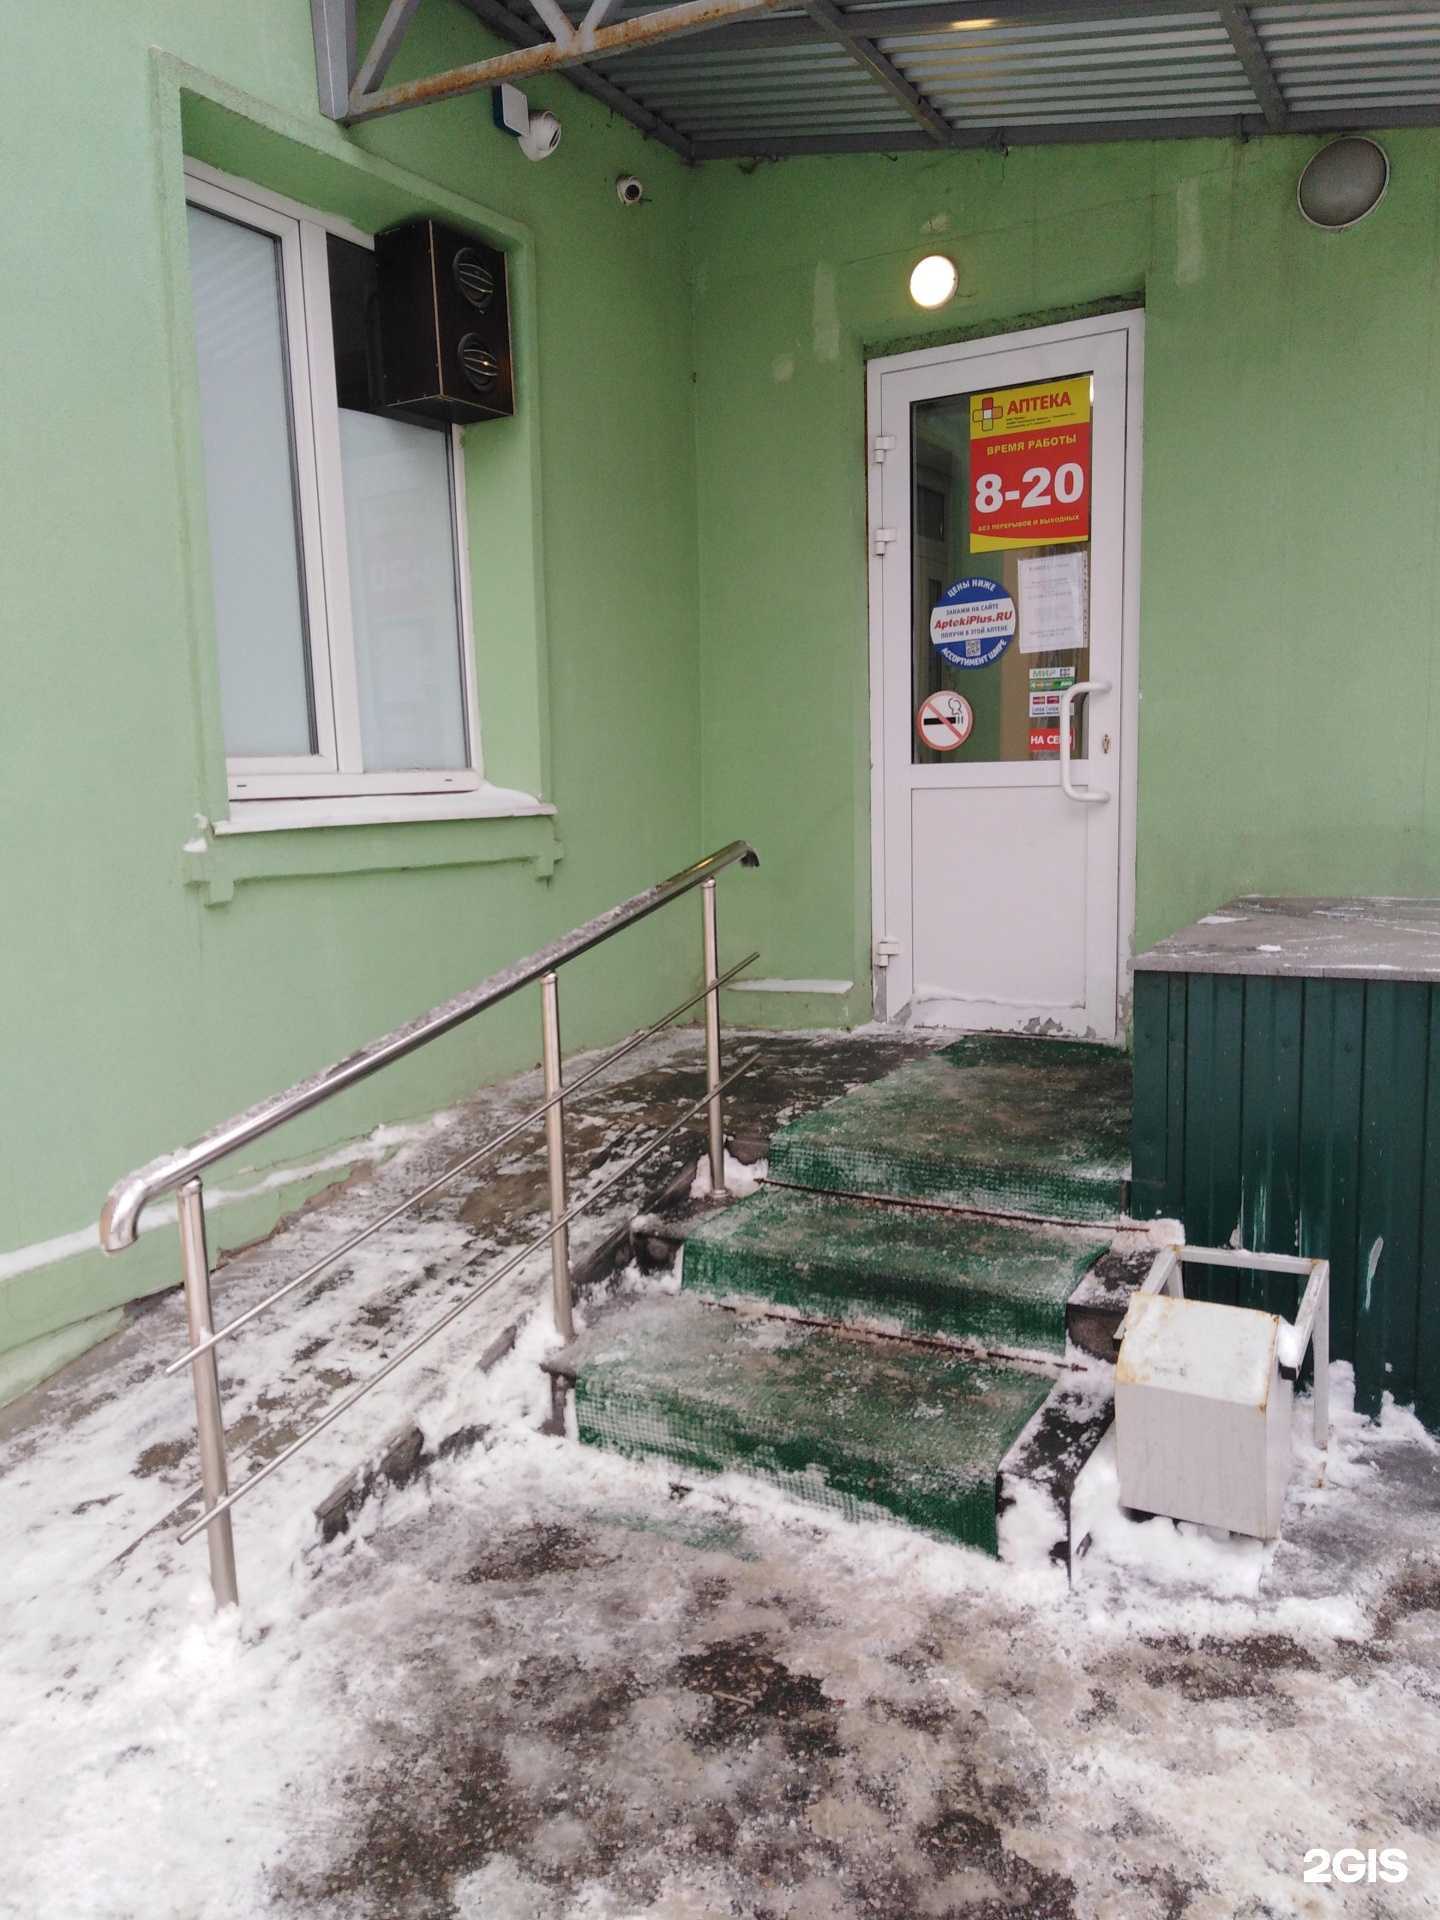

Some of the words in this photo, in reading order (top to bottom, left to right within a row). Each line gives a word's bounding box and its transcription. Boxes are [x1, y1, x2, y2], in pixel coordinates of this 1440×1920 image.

[1007, 391, 1072, 415] АПТЕКА
[987, 441, 1025, 456] ВРЕМЯ
[1028, 434, 1077, 449] РАБОТЫ
[975, 463, 1084, 513] 8-20
[947, 580, 970, 598] ЦЕНЫ
[971, 579, 997, 592] НИЖЕ
[934, 611, 1013, 630] AptekiPlus.RU
[941, 647, 989, 666] АССОРТИМЕНТ
[988, 639, 1007, 660] ШИРЕ
[1031, 735, 1044, 744] НА
